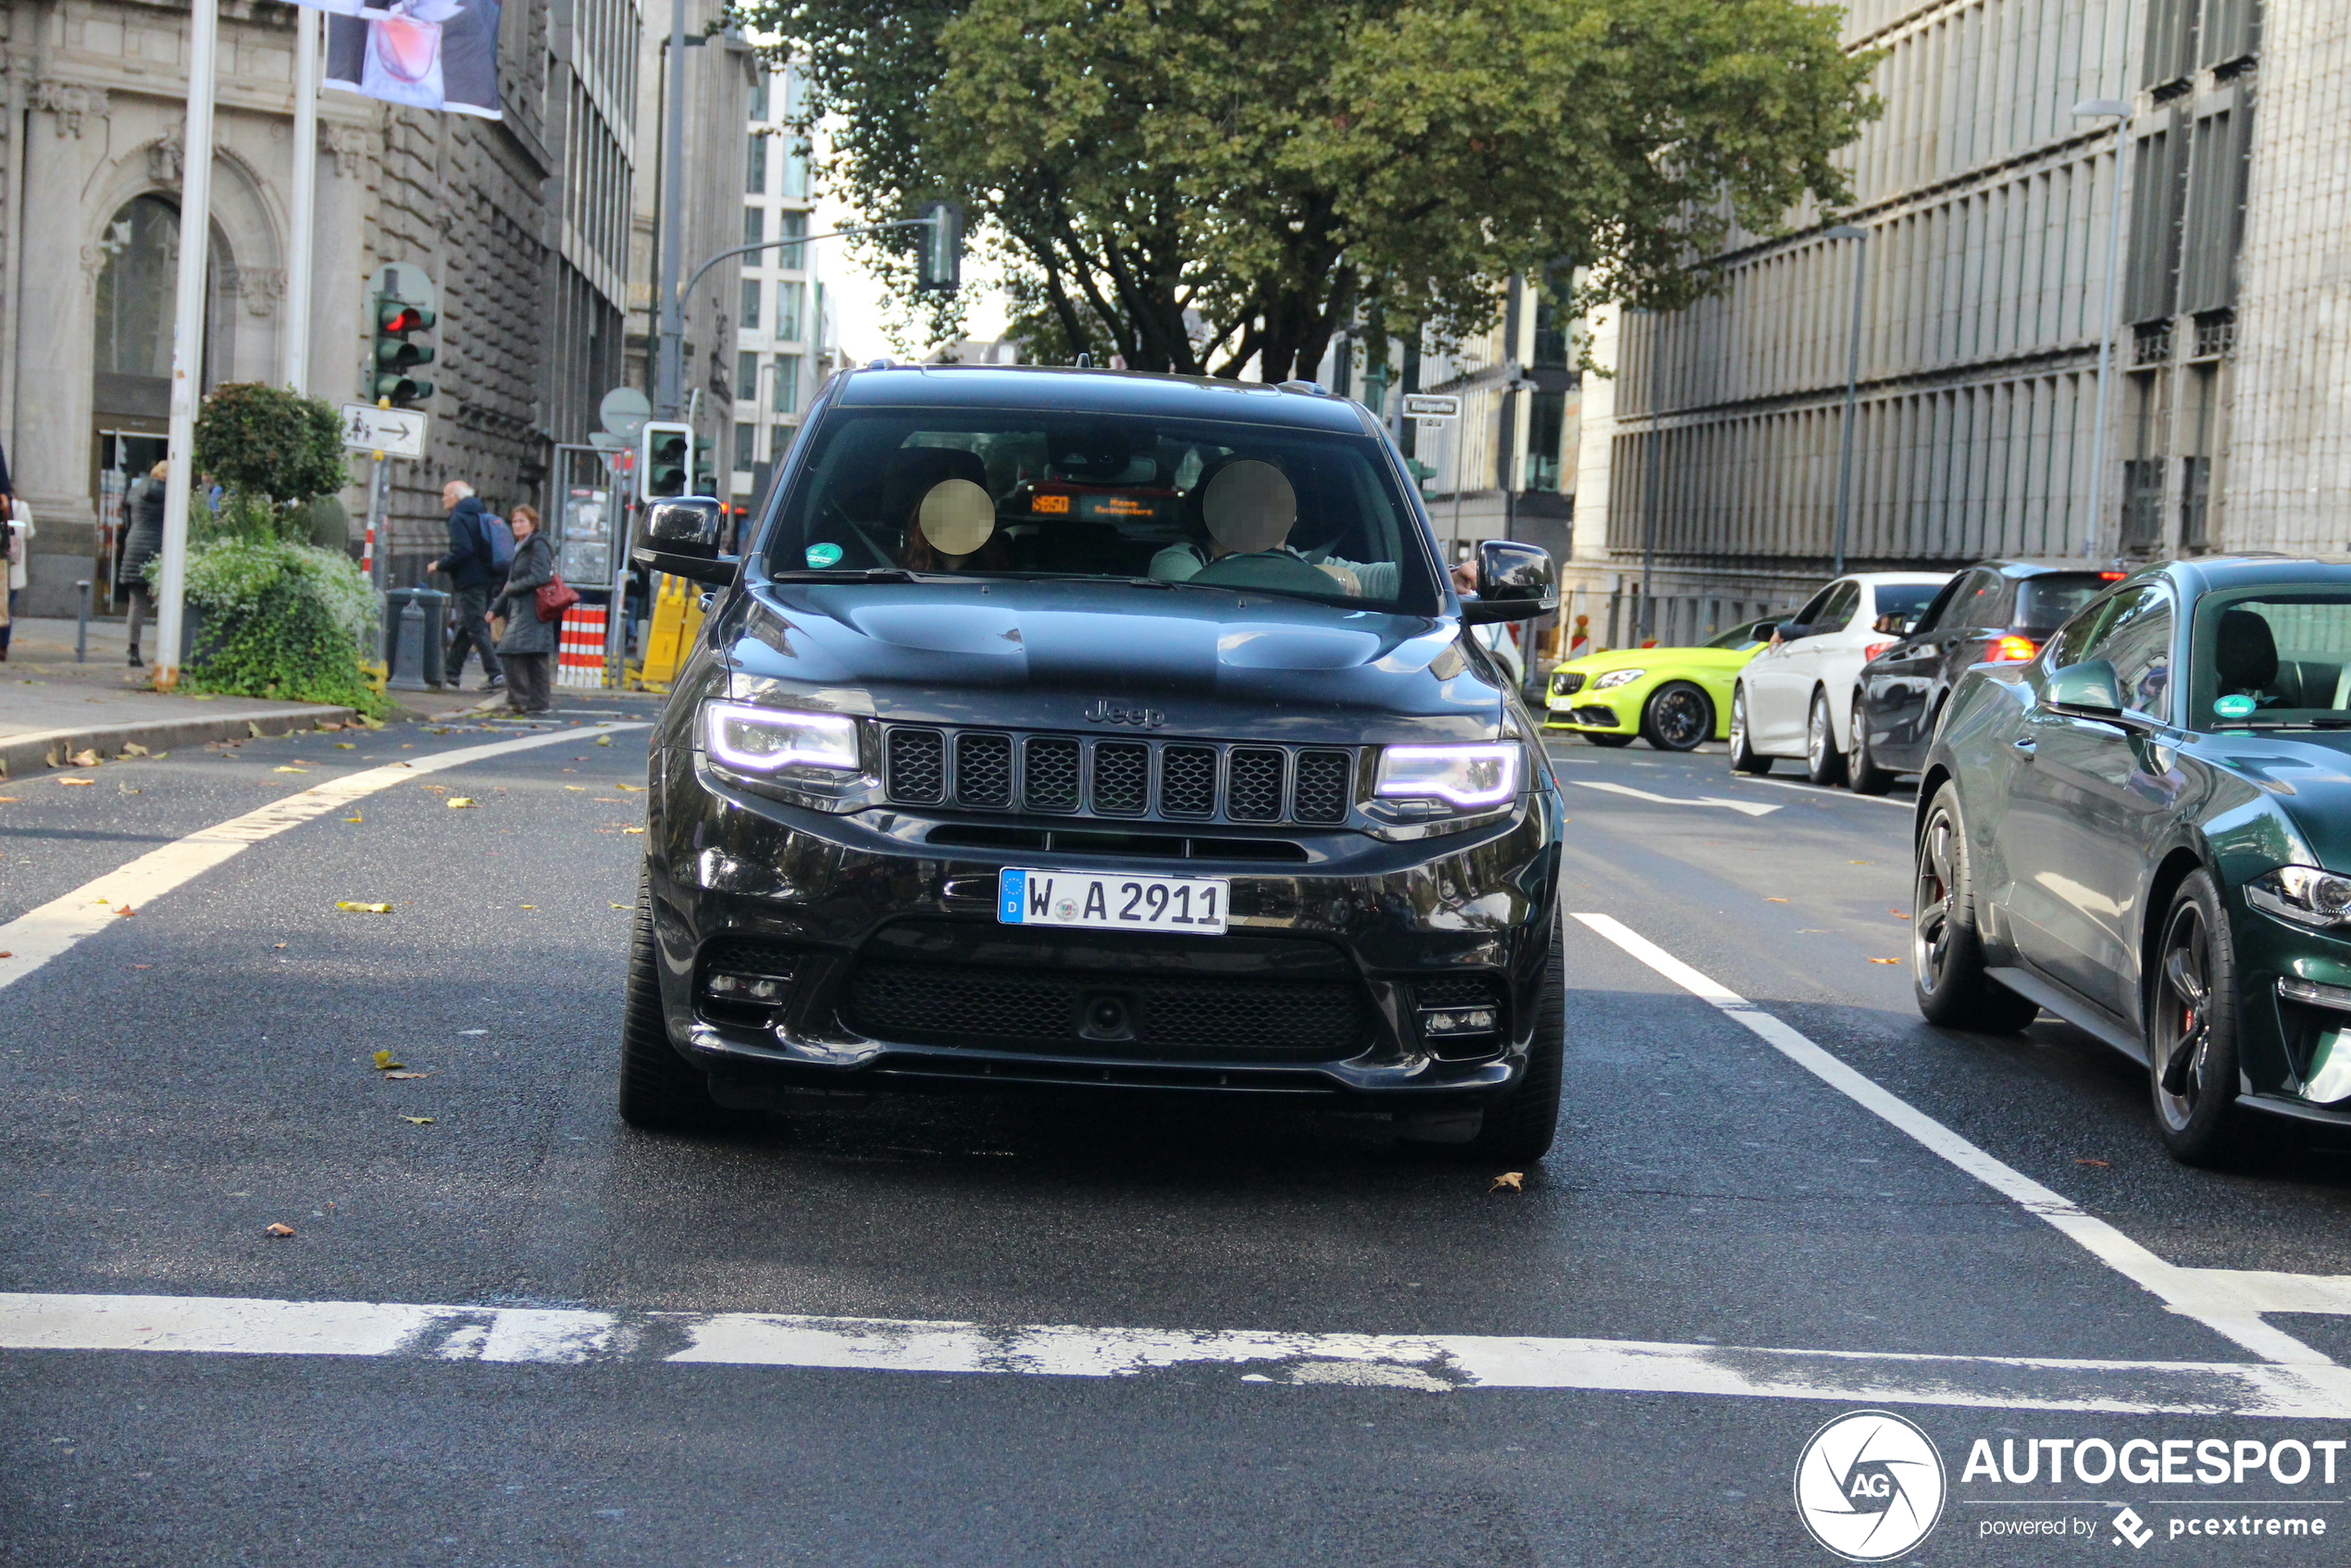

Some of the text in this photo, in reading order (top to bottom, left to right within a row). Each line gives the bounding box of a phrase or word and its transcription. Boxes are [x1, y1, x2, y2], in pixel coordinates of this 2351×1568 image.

[1085, 700, 1165, 730] Jeep
[1007, 901, 1017, 913] D
[1028, 877, 1221, 926] W A 2911
